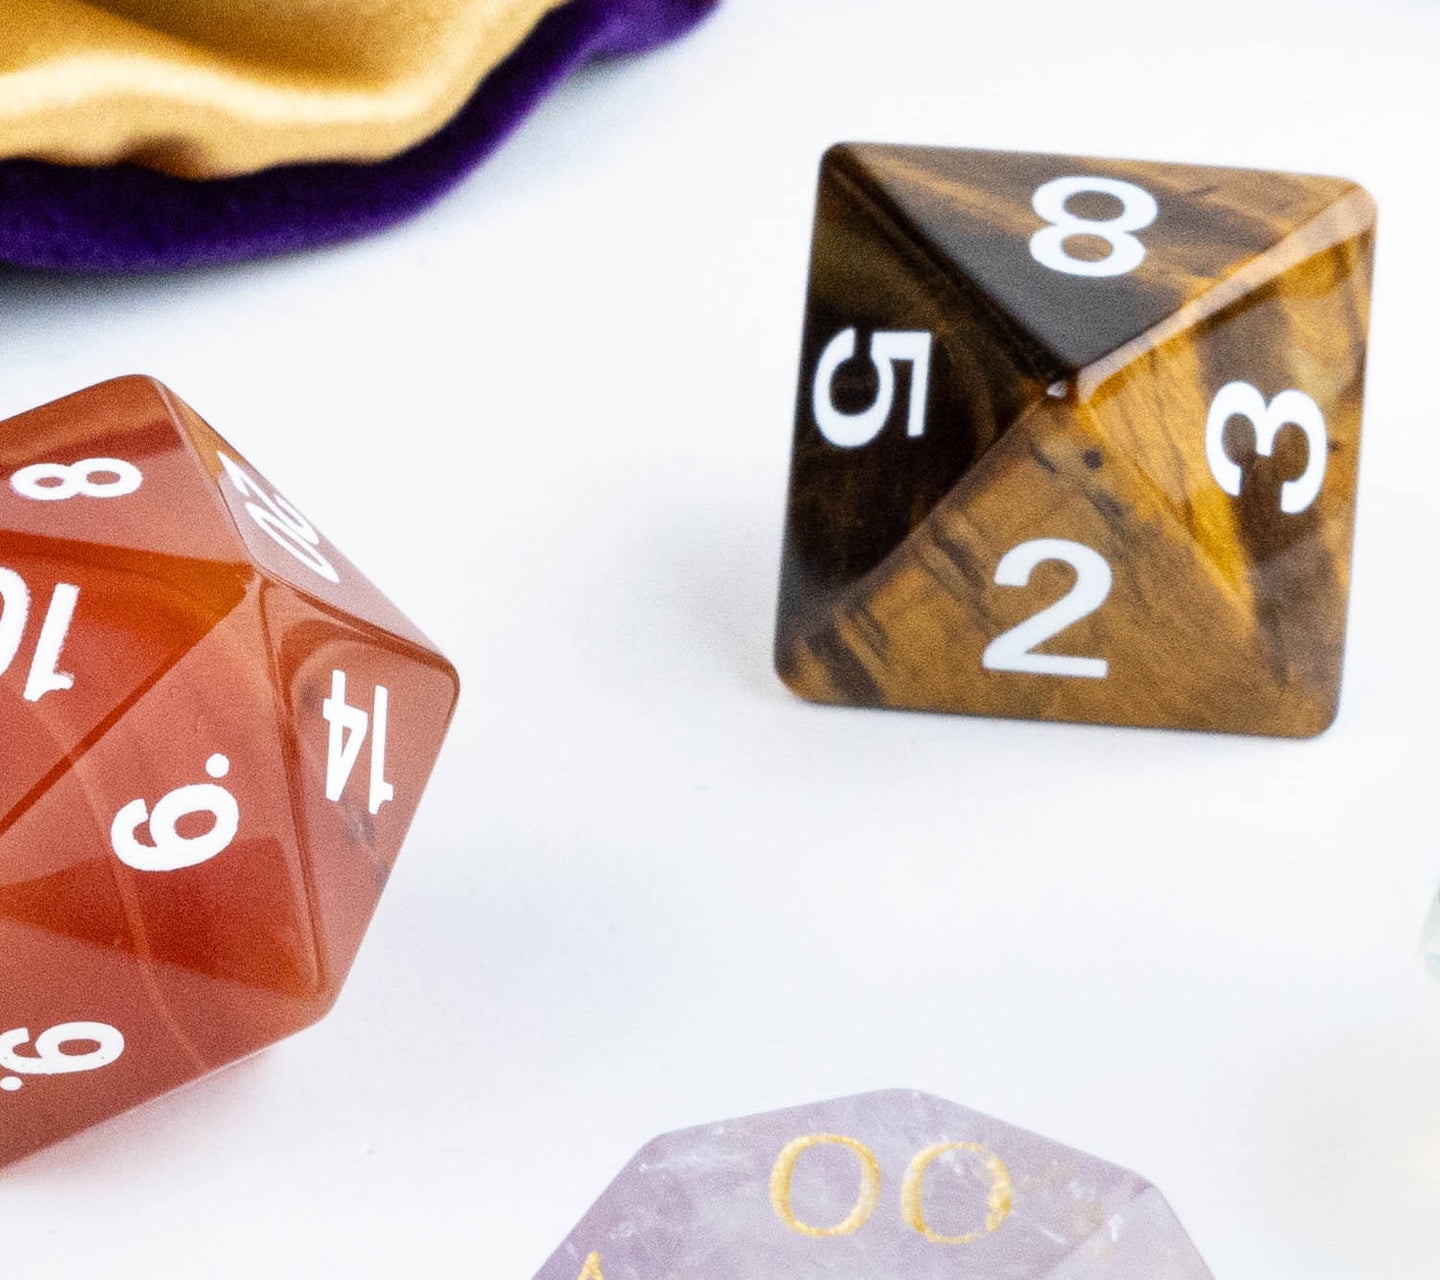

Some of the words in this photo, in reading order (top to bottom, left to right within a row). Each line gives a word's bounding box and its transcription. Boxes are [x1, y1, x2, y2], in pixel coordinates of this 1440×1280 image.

[1029, 176, 1158, 278] 8
[813, 327, 931, 447] 5
[9, 457, 142, 502] 8
[1205, 381, 1327, 514] 3
[982, 538, 1112, 679] 2
[323, 669, 394, 815] 14
[770, 1134, 1012, 1244] 00
